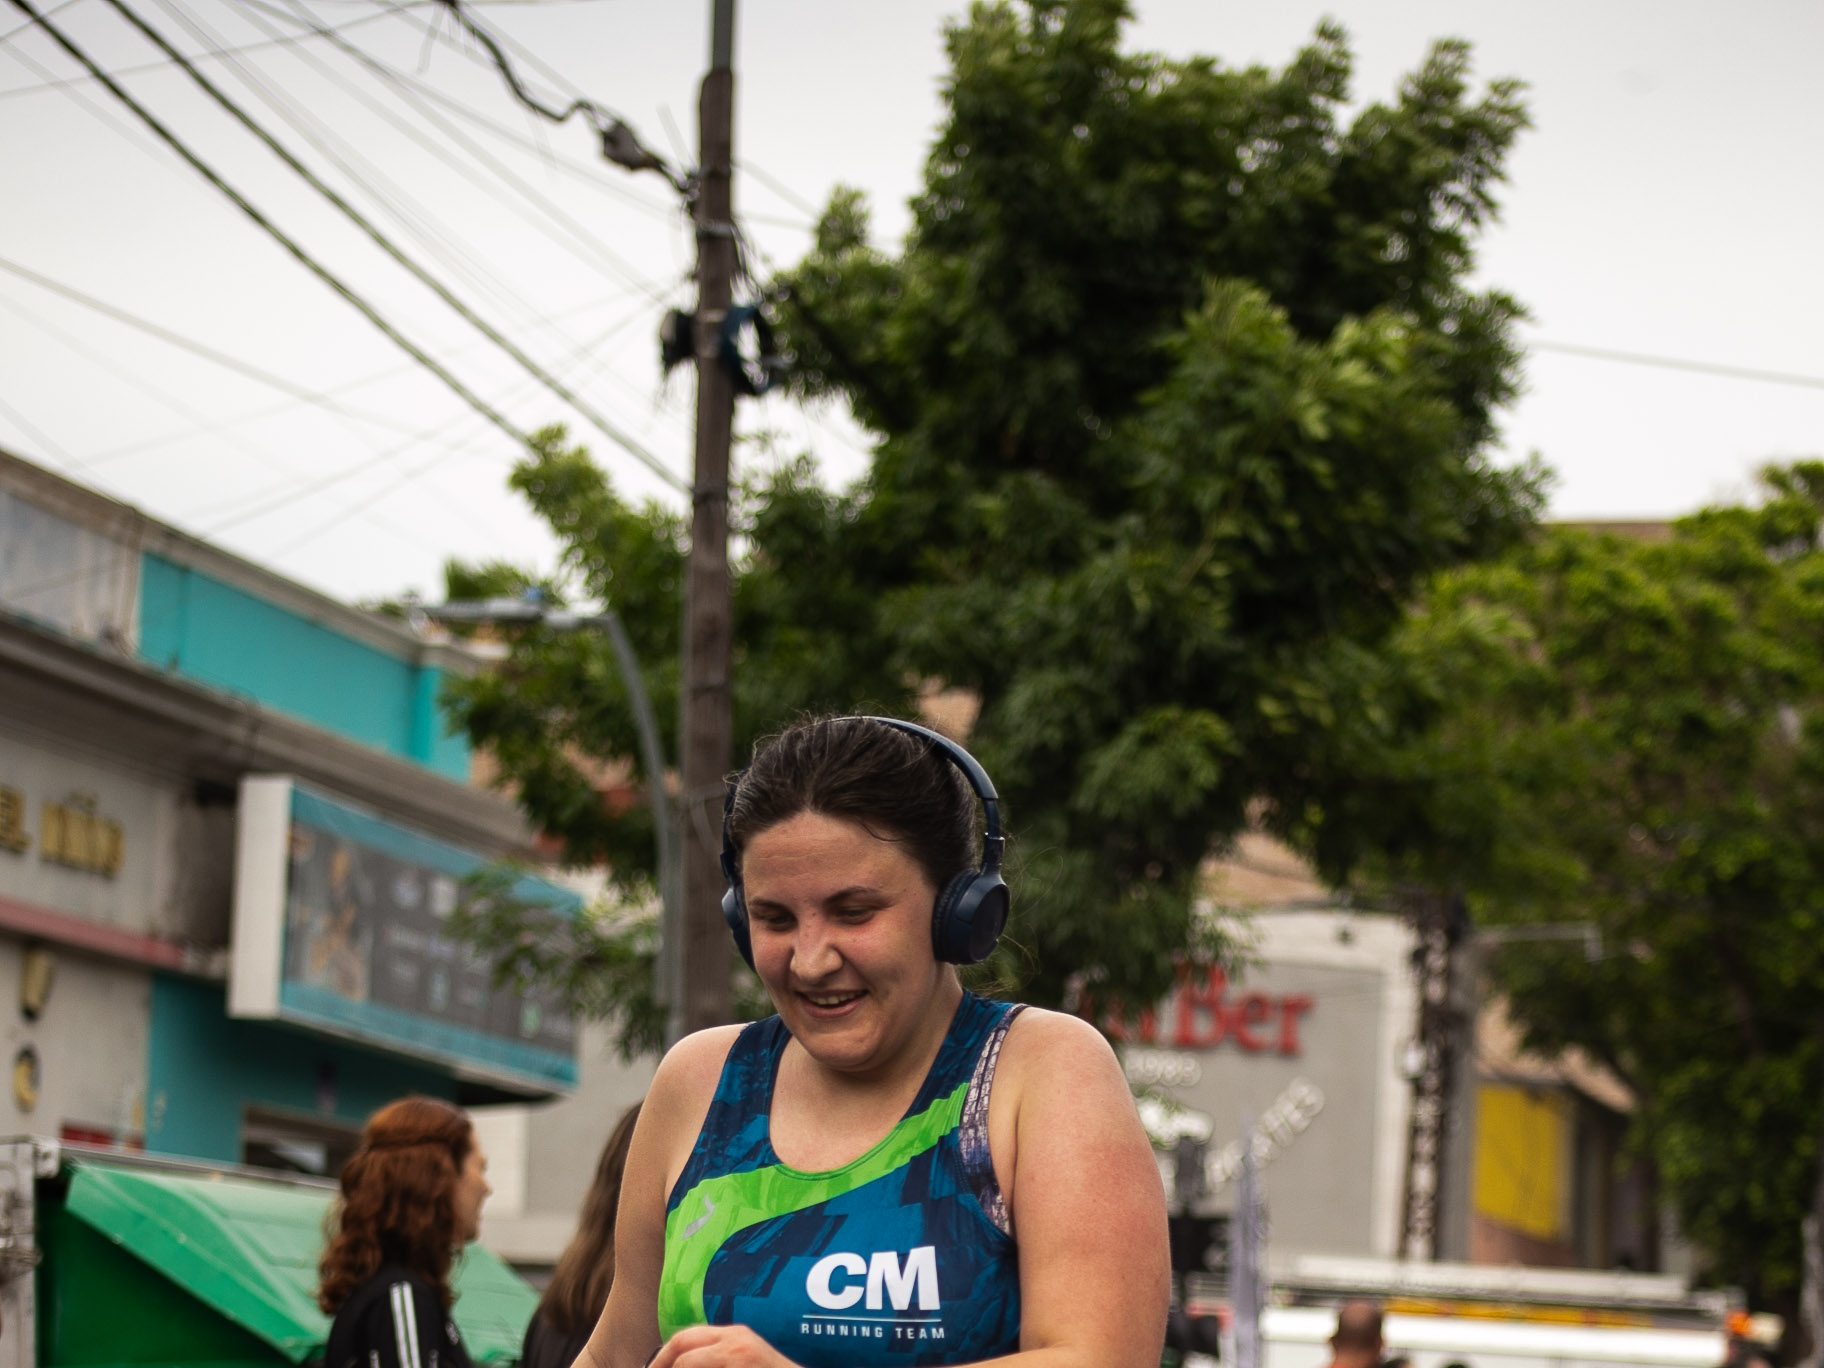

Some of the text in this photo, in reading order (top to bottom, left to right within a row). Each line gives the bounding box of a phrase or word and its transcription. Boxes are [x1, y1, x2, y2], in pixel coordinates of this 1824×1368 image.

[805, 1245, 941, 1311] CM
[801, 1323, 946, 1340] RUNNING TEAM
